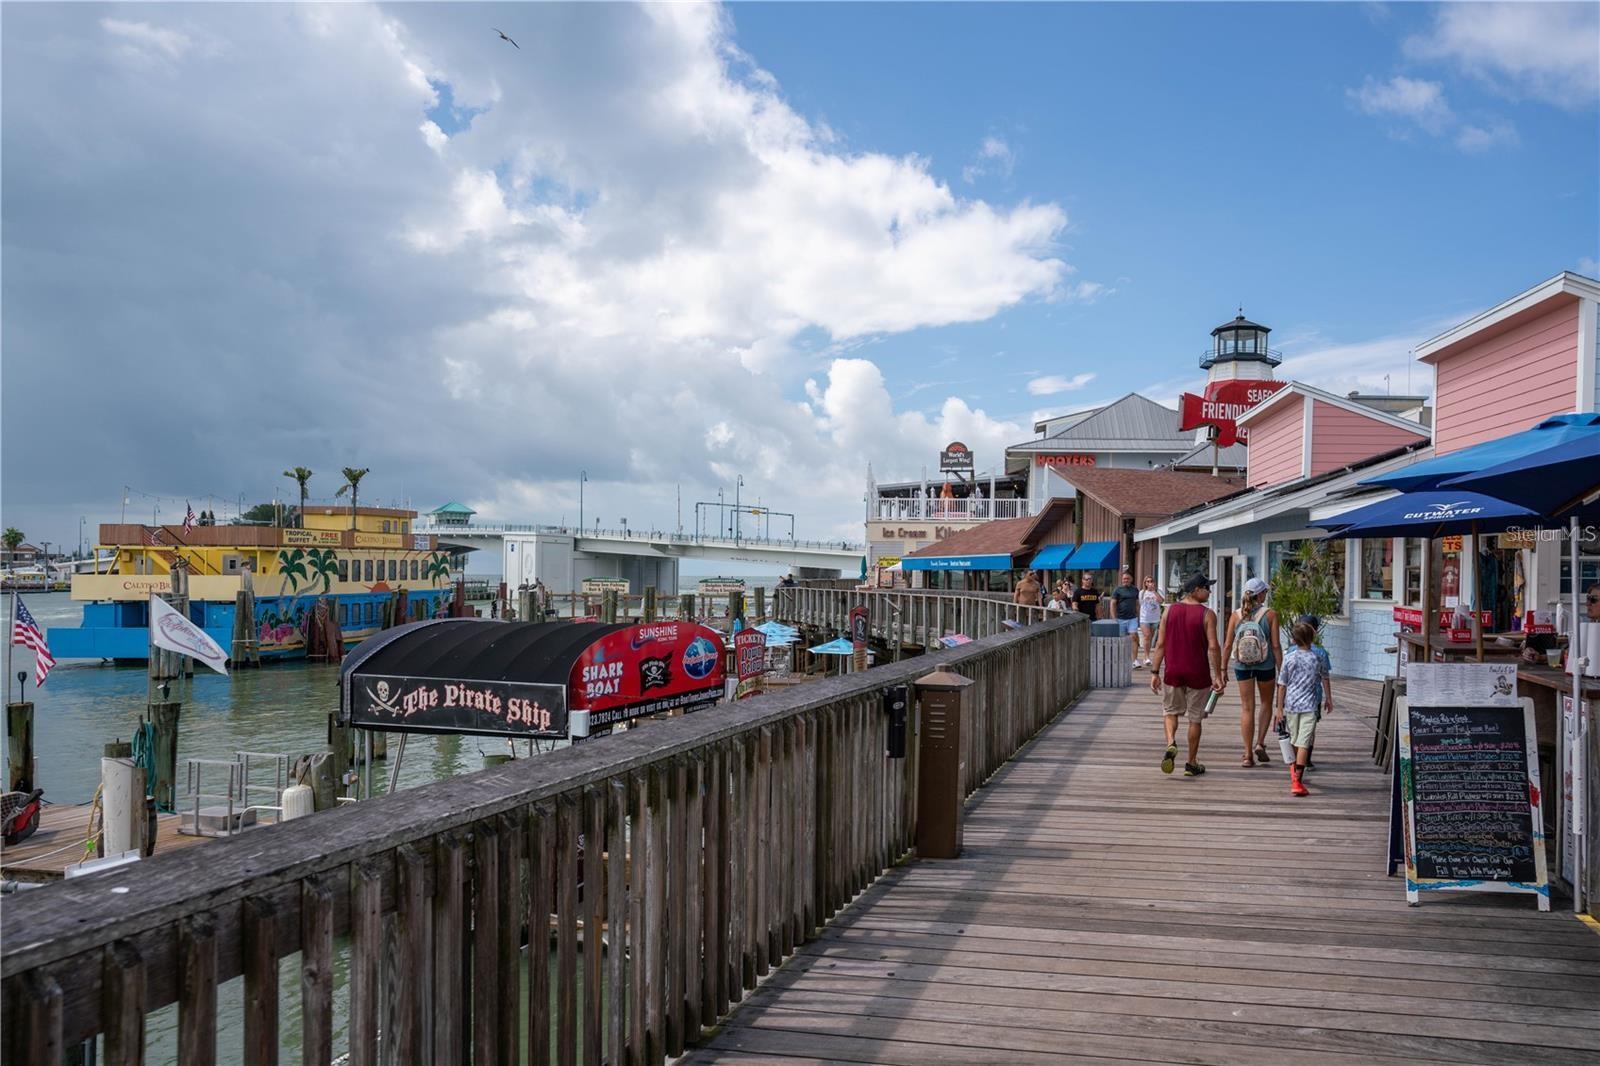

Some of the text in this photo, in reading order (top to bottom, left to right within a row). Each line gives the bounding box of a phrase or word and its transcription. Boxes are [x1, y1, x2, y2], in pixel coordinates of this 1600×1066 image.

[1036, 454, 1096, 466] HOOTERS
[1404, 508, 1481, 519] CUTWATER
[639, 625, 678, 640] SUNSHINE
[736, 634, 765, 644] TICKETS
[582, 661, 624, 683] SHARK
[586, 677, 620, 699] BOAT
[403, 683, 551, 732] The Pirate Ship
